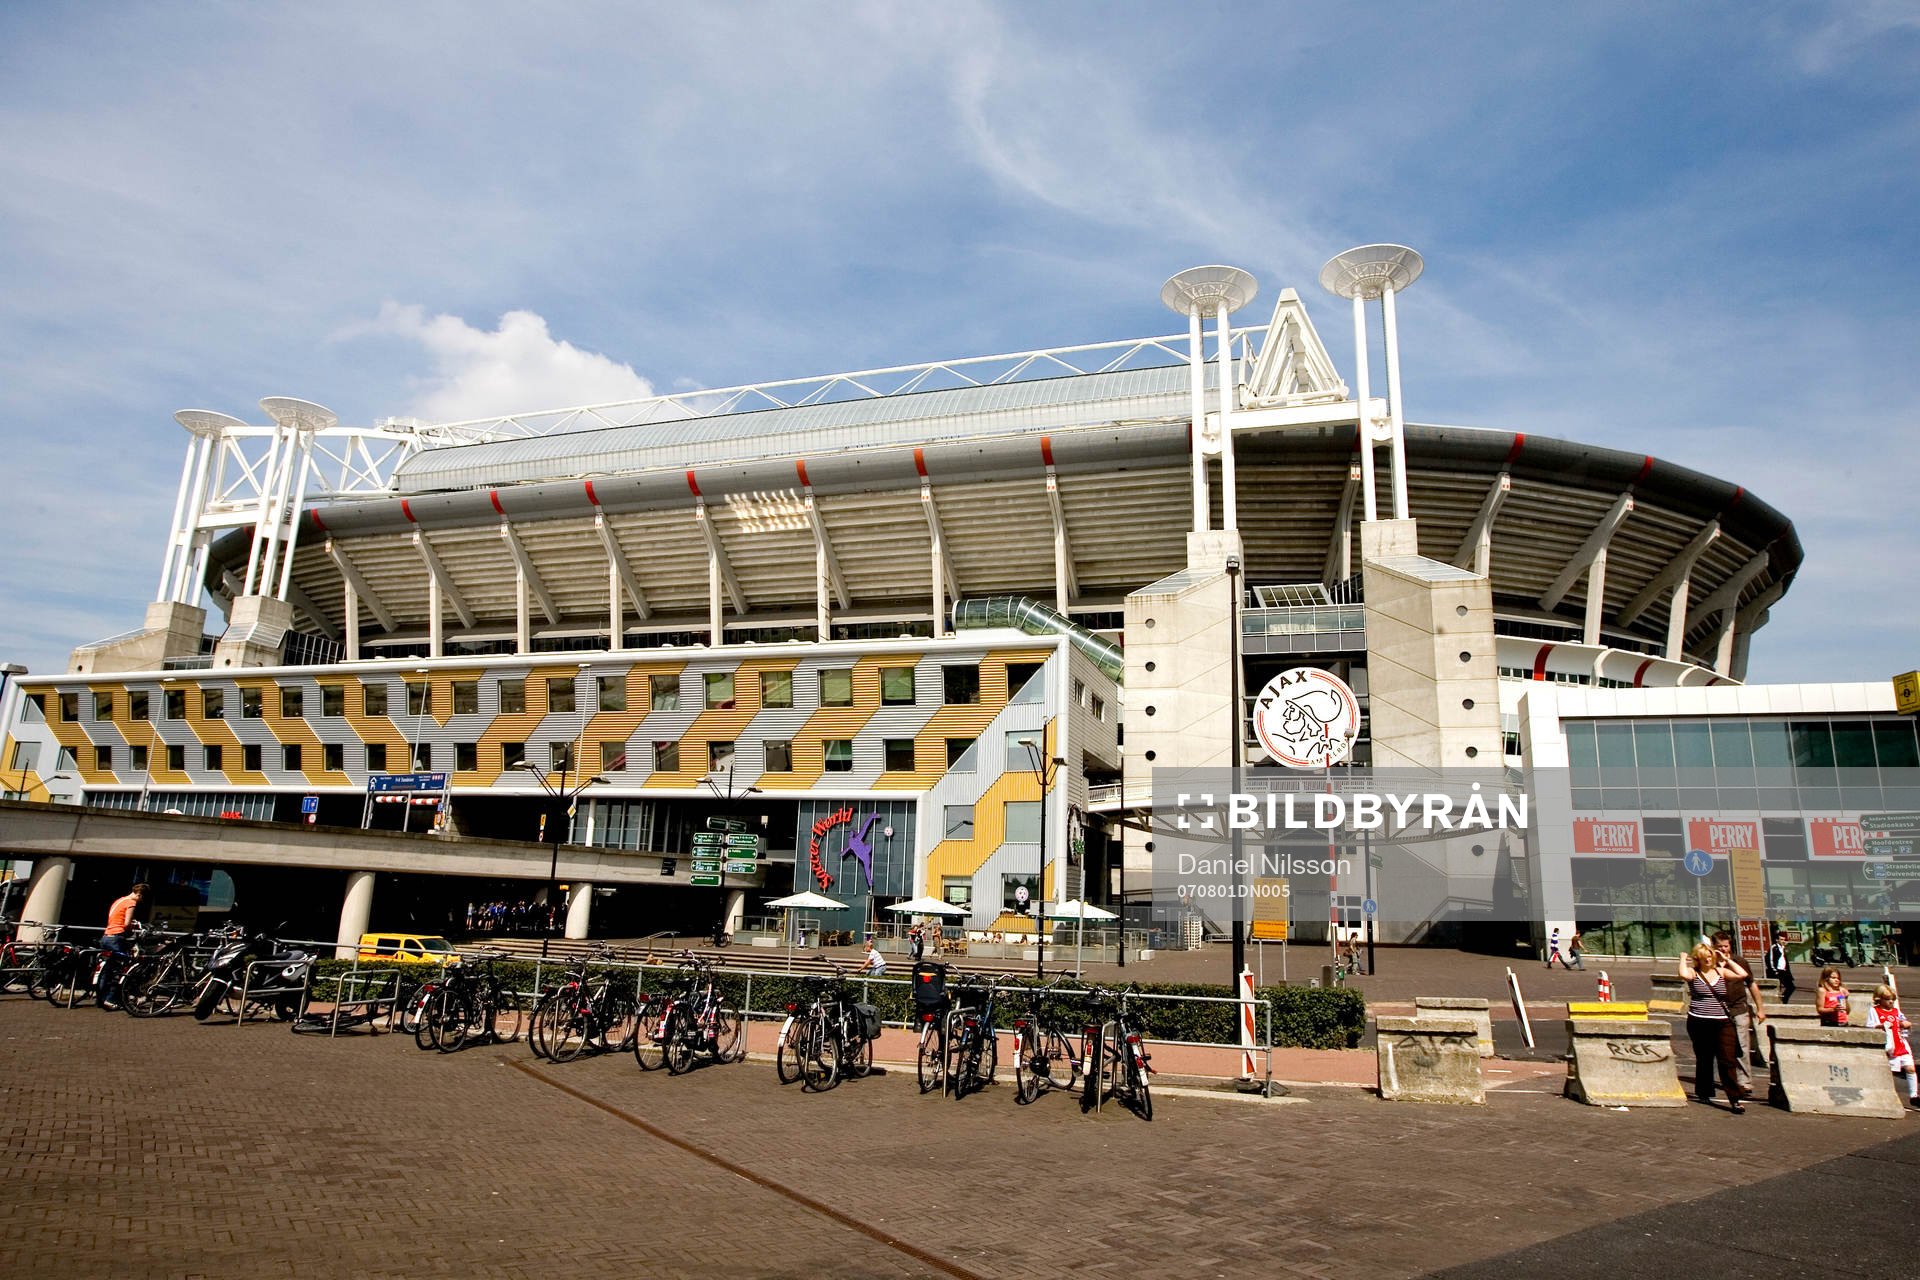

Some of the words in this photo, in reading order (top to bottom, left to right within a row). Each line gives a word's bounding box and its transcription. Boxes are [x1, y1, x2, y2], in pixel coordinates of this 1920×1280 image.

[1260, 670, 1307, 710] AJAX
[812, 807, 854, 837] World
[1593, 824, 1635, 847] PERRY
[1709, 824, 1753, 848] PERRY
[1832, 825, 1876, 849] PER
[809, 839, 834, 889] Soccer
